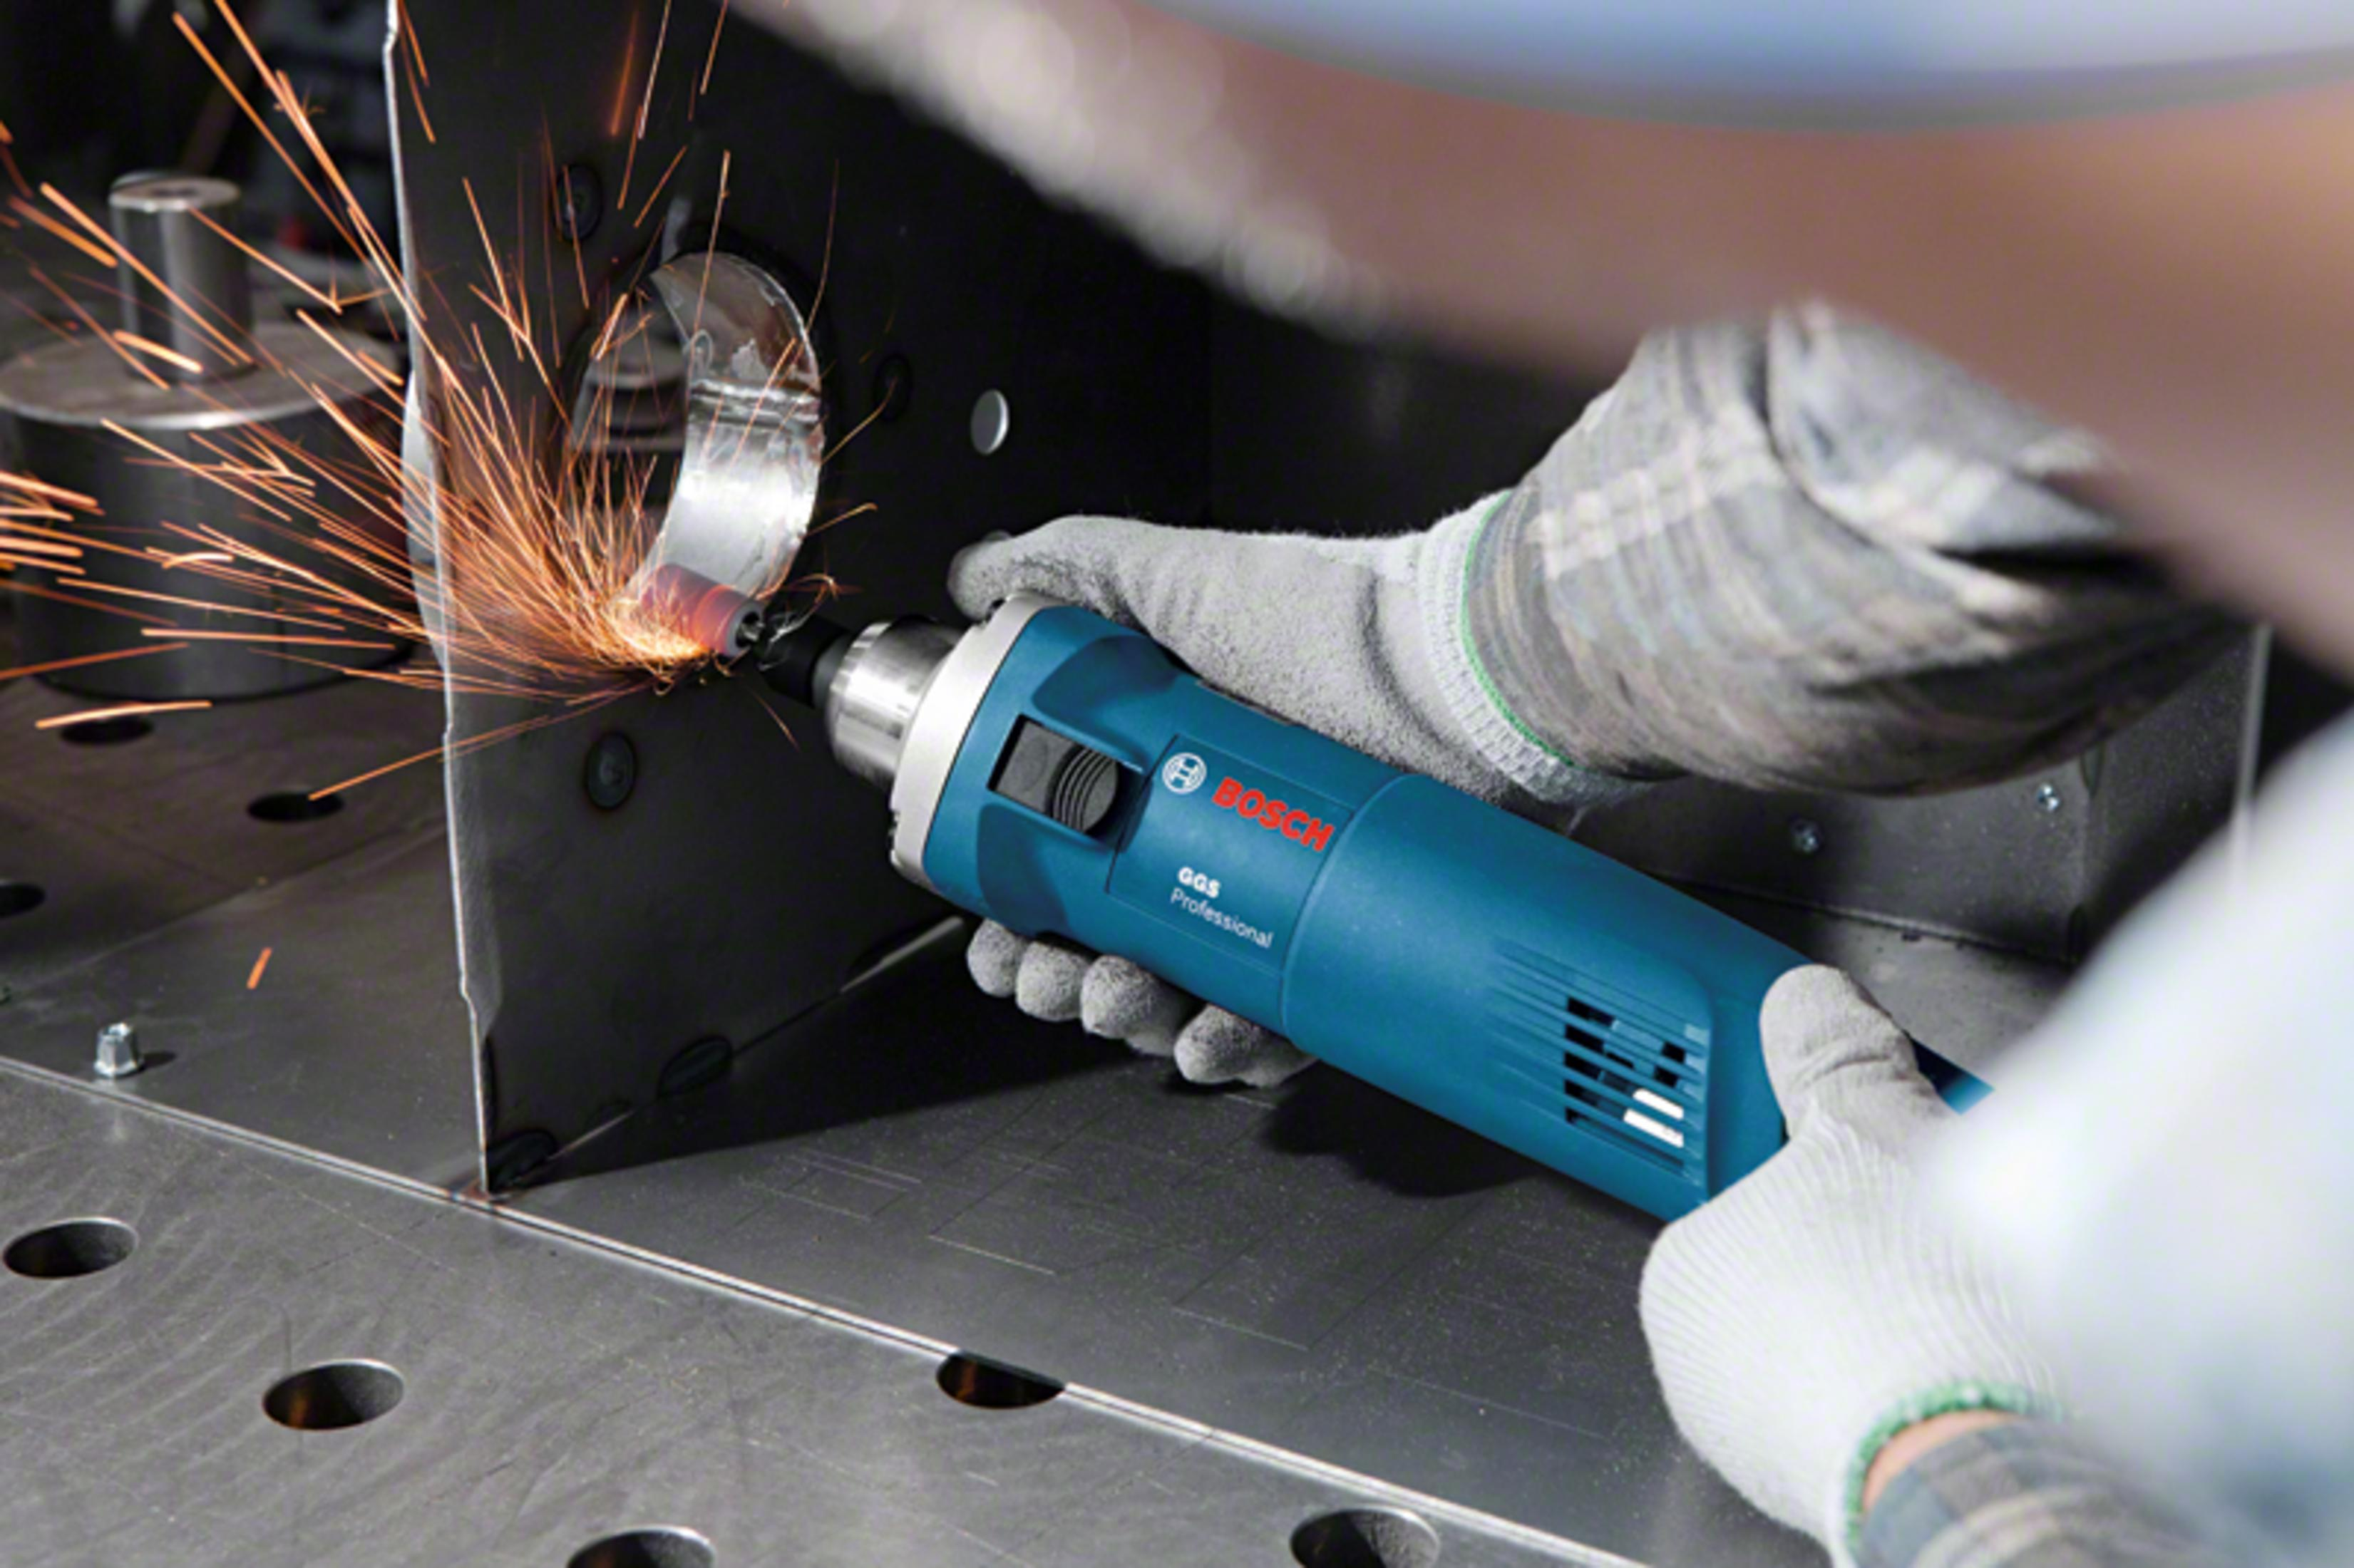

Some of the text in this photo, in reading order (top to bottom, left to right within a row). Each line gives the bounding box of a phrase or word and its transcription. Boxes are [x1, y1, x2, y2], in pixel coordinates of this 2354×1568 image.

[1213, 777, 1335, 851] BOSCH
[1178, 867, 1220, 898] GGS
[1171, 887, 1274, 948] Professional
